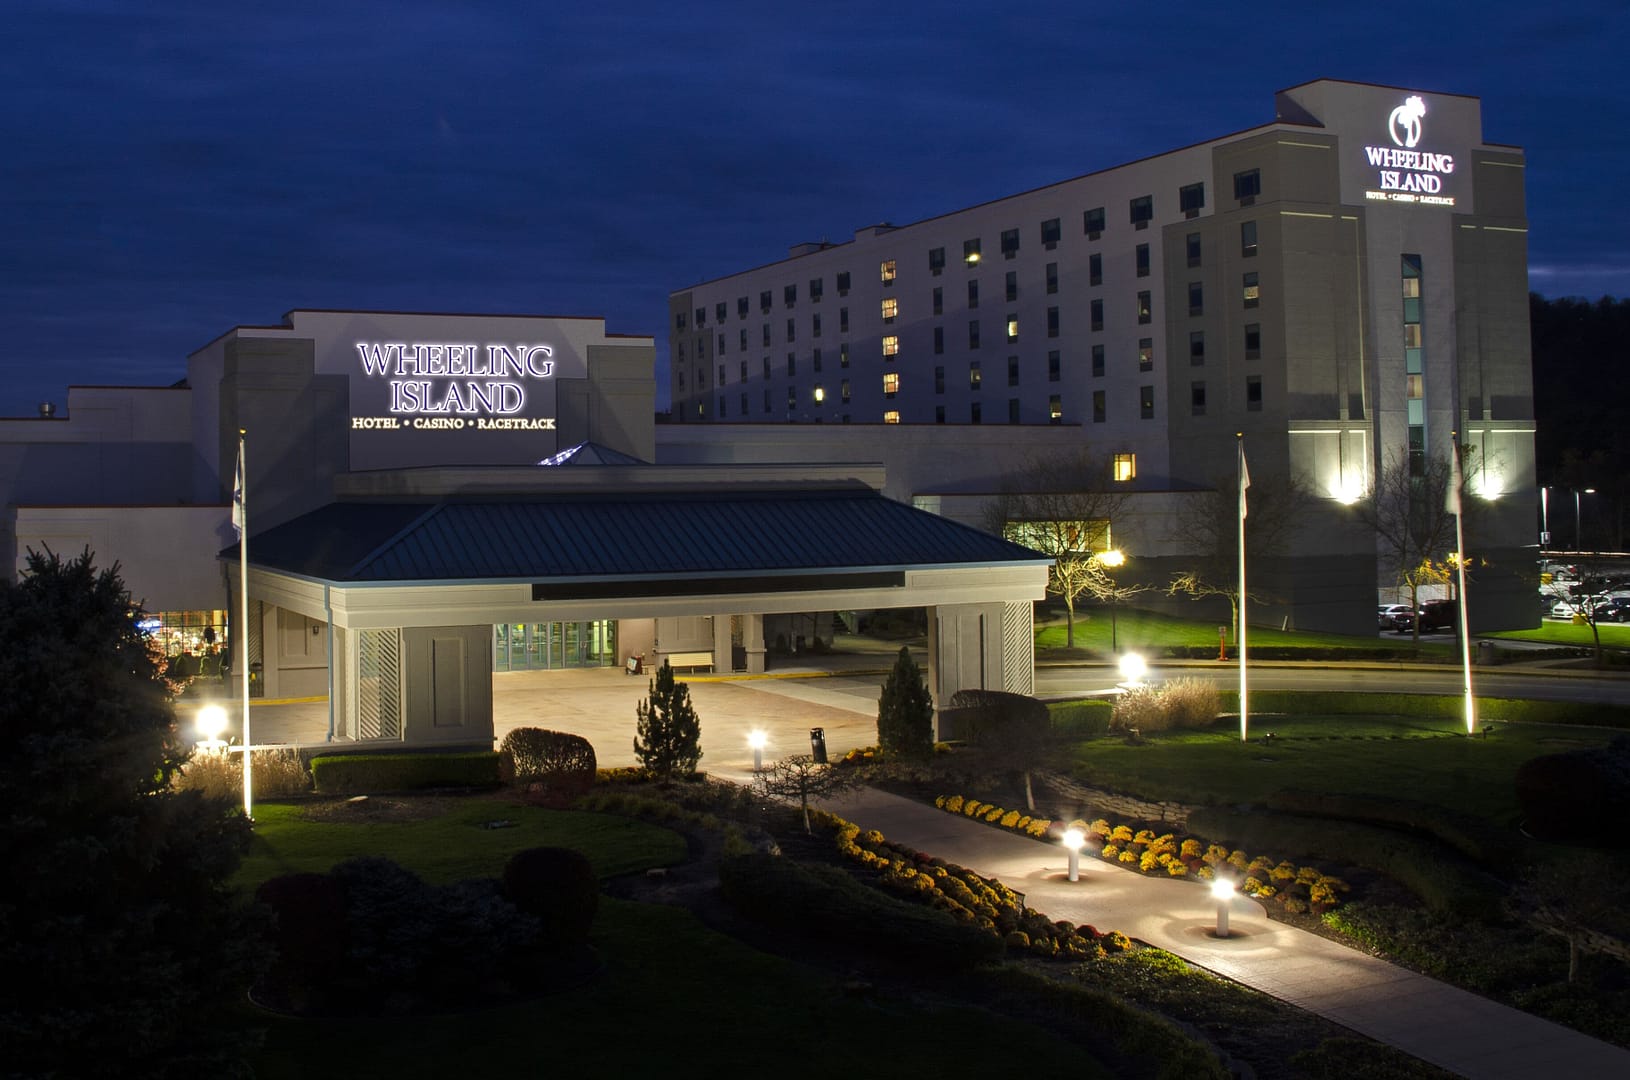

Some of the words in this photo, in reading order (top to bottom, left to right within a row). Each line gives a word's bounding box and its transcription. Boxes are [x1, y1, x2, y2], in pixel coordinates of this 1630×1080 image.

[1365, 147, 1454, 173] WHEELING
[1380, 171, 1441, 193] ISLAND
[356, 342, 554, 378] WHEELING
[390, 380, 525, 414] ISLAND
[352, 418, 400, 429] HOTEL
[413, 418, 464, 429] CASINO
[477, 418, 556, 430] RACETRACK
